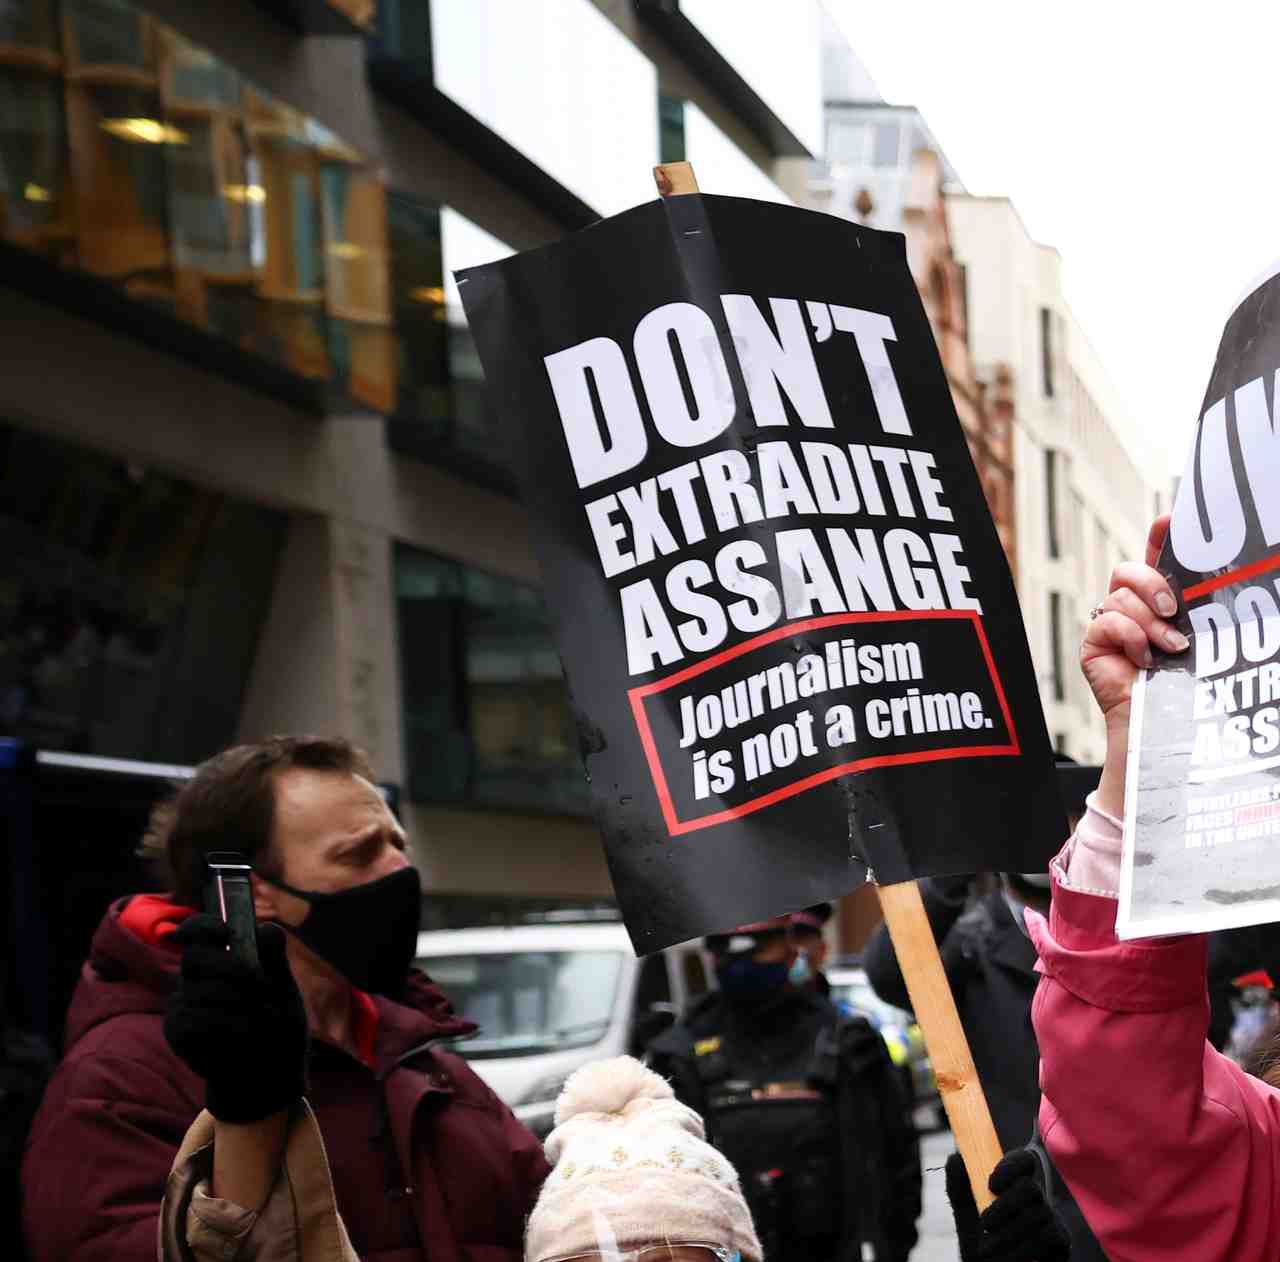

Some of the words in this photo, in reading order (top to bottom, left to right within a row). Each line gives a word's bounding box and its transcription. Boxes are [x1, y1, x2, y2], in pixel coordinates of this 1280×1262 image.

[543, 294, 913, 489] DON'T
[585, 441, 953, 578] EXTRADITE
[618, 528, 982, 677] ASSANGE
[679, 638, 924, 748] Journalism
[692, 749, 735, 800] is
[741, 709, 818, 781] not
[824, 704, 857, 747] a
[865, 687, 994, 738] crime.
